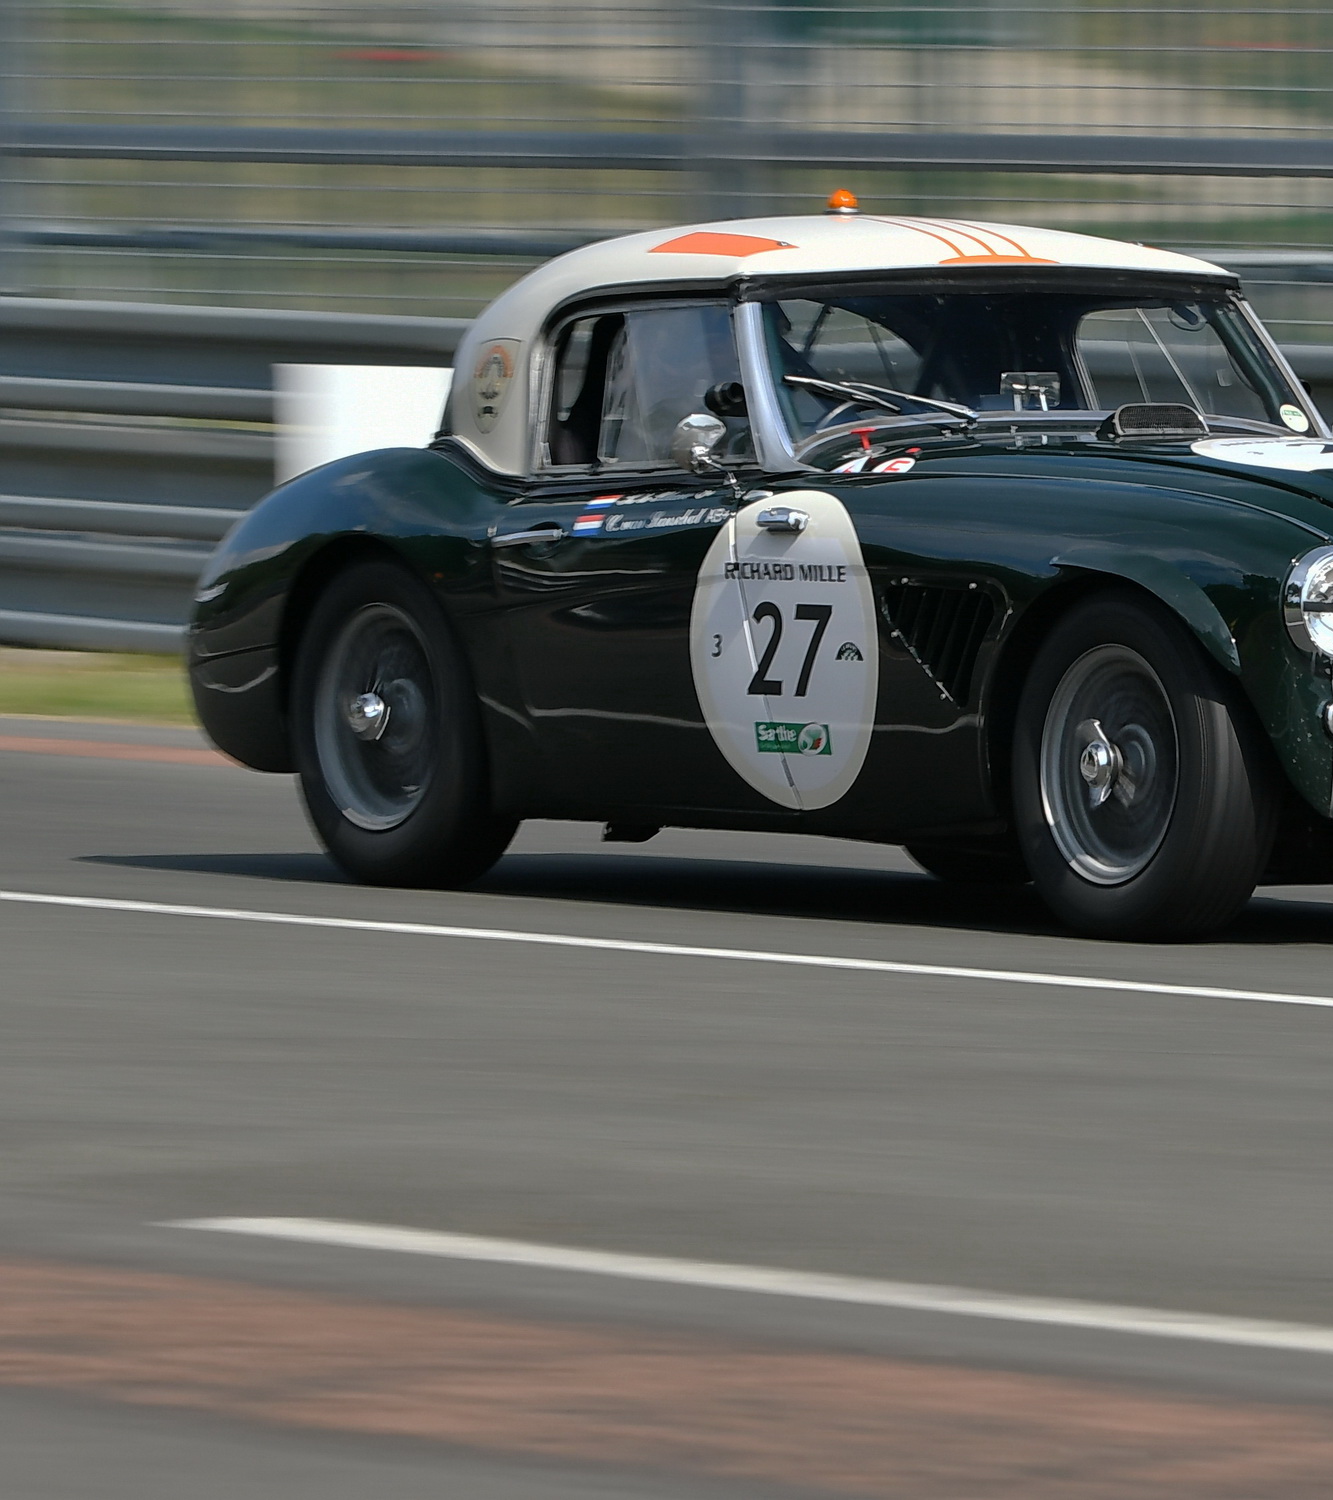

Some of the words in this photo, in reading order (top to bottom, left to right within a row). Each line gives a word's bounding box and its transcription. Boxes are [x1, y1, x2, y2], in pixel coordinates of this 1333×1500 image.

[724, 562, 794, 580] RICHARD
[799, 564, 847, 582] MILLE
[710, 633, 723, 658] 3
[747, 601, 833, 697] 27
